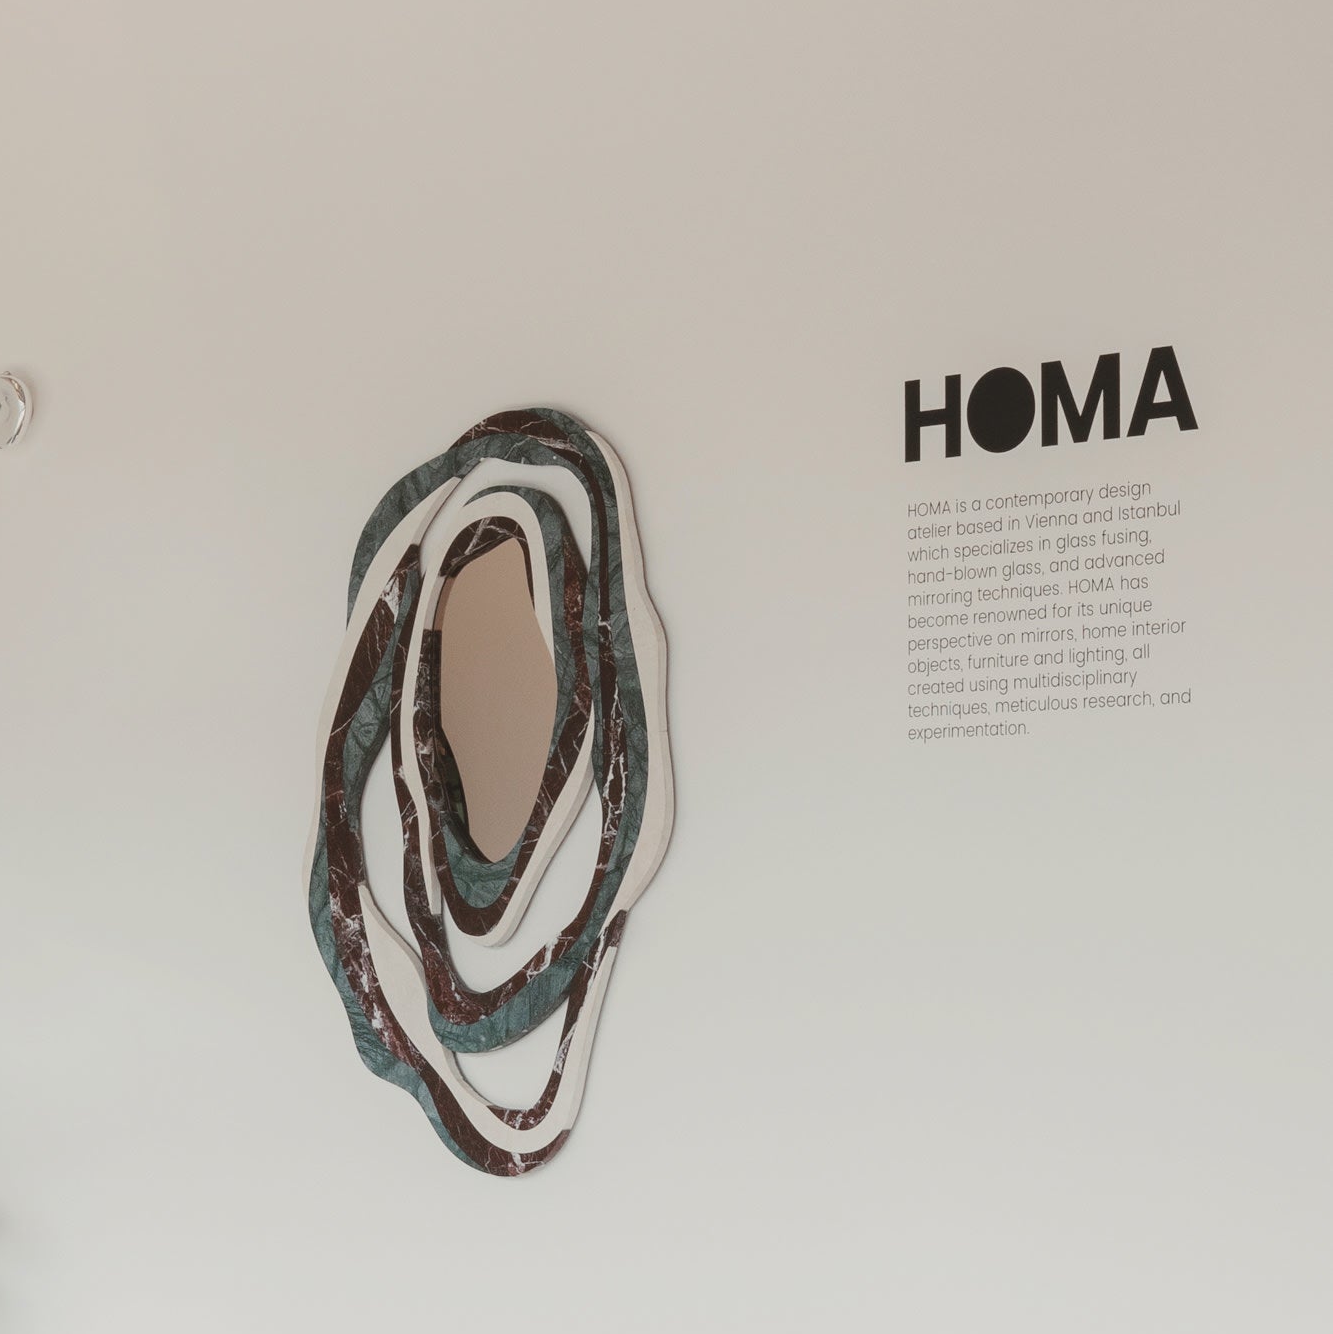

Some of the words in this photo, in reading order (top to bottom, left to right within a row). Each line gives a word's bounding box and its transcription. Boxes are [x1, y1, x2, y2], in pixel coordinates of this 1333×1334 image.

[905, 346, 1198, 462] HOMA
[908, 500, 951, 518] HOMA
[955, 499, 967, 513] is
[971, 499, 981, 512] a
[985, 488, 1094, 510] contemporary
[1098, 480, 1151, 501] design
[907, 523, 952, 540] atelier
[956, 517, 1003, 536] based
[1008, 515, 1020, 531] in
[1025, 513, 1078, 529] Vienna
[1082, 506, 1113, 524] and
[1118, 499, 1181, 521] Istanbul
[907, 544, 949, 562] which
[954, 539, 1033, 562] specializes
[1038, 535, 1051, 551] in
[1056, 533, 1096, 554] glass
[1101, 528, 1152, 547] fusing,
[907, 565, 997, 585] hand-blown
[1002, 560, 1045, 582] glass,
[1049, 555, 1079, 573] and
[1084, 548, 1165, 570] advanced
[908, 588, 973, 608] mirroring
[977, 583, 1063, 602] techniques.
[1068, 576, 1115, 594] HOMA
[1120, 575, 1149, 590] has
[908, 613, 969, 629] become
[973, 604, 1047, 624] renowned
[1052, 603, 1072, 618] for
[1077, 601, 1094, 617] its
[1099, 598, 1153, 618] unique
[908, 632, 993, 656] perspective
[997, 632, 1016, 646] on
[1021, 627, 1077, 644] mirrors,
[1082, 624, 1127, 640] home
[1132, 618, 1186, 636] interior
[907, 657, 963, 677] objects,
[967, 653, 1029, 670] furniture
[1033, 649, 1064, 666] and
[1069, 646, 1128, 668] lighting,
[1132, 643, 1150, 660] all
[907, 677, 964, 696] created
[969, 676, 1008, 696] using
[1013, 669, 1138, 691] multidisciplinary
[908, 701, 990, 720] techniques,
[995, 695, 1078, 713] meticulous
[1083, 691, 1155, 709] research,
[1160, 687, 1191, 705] and
[908, 720, 1030, 744] experimentation.
